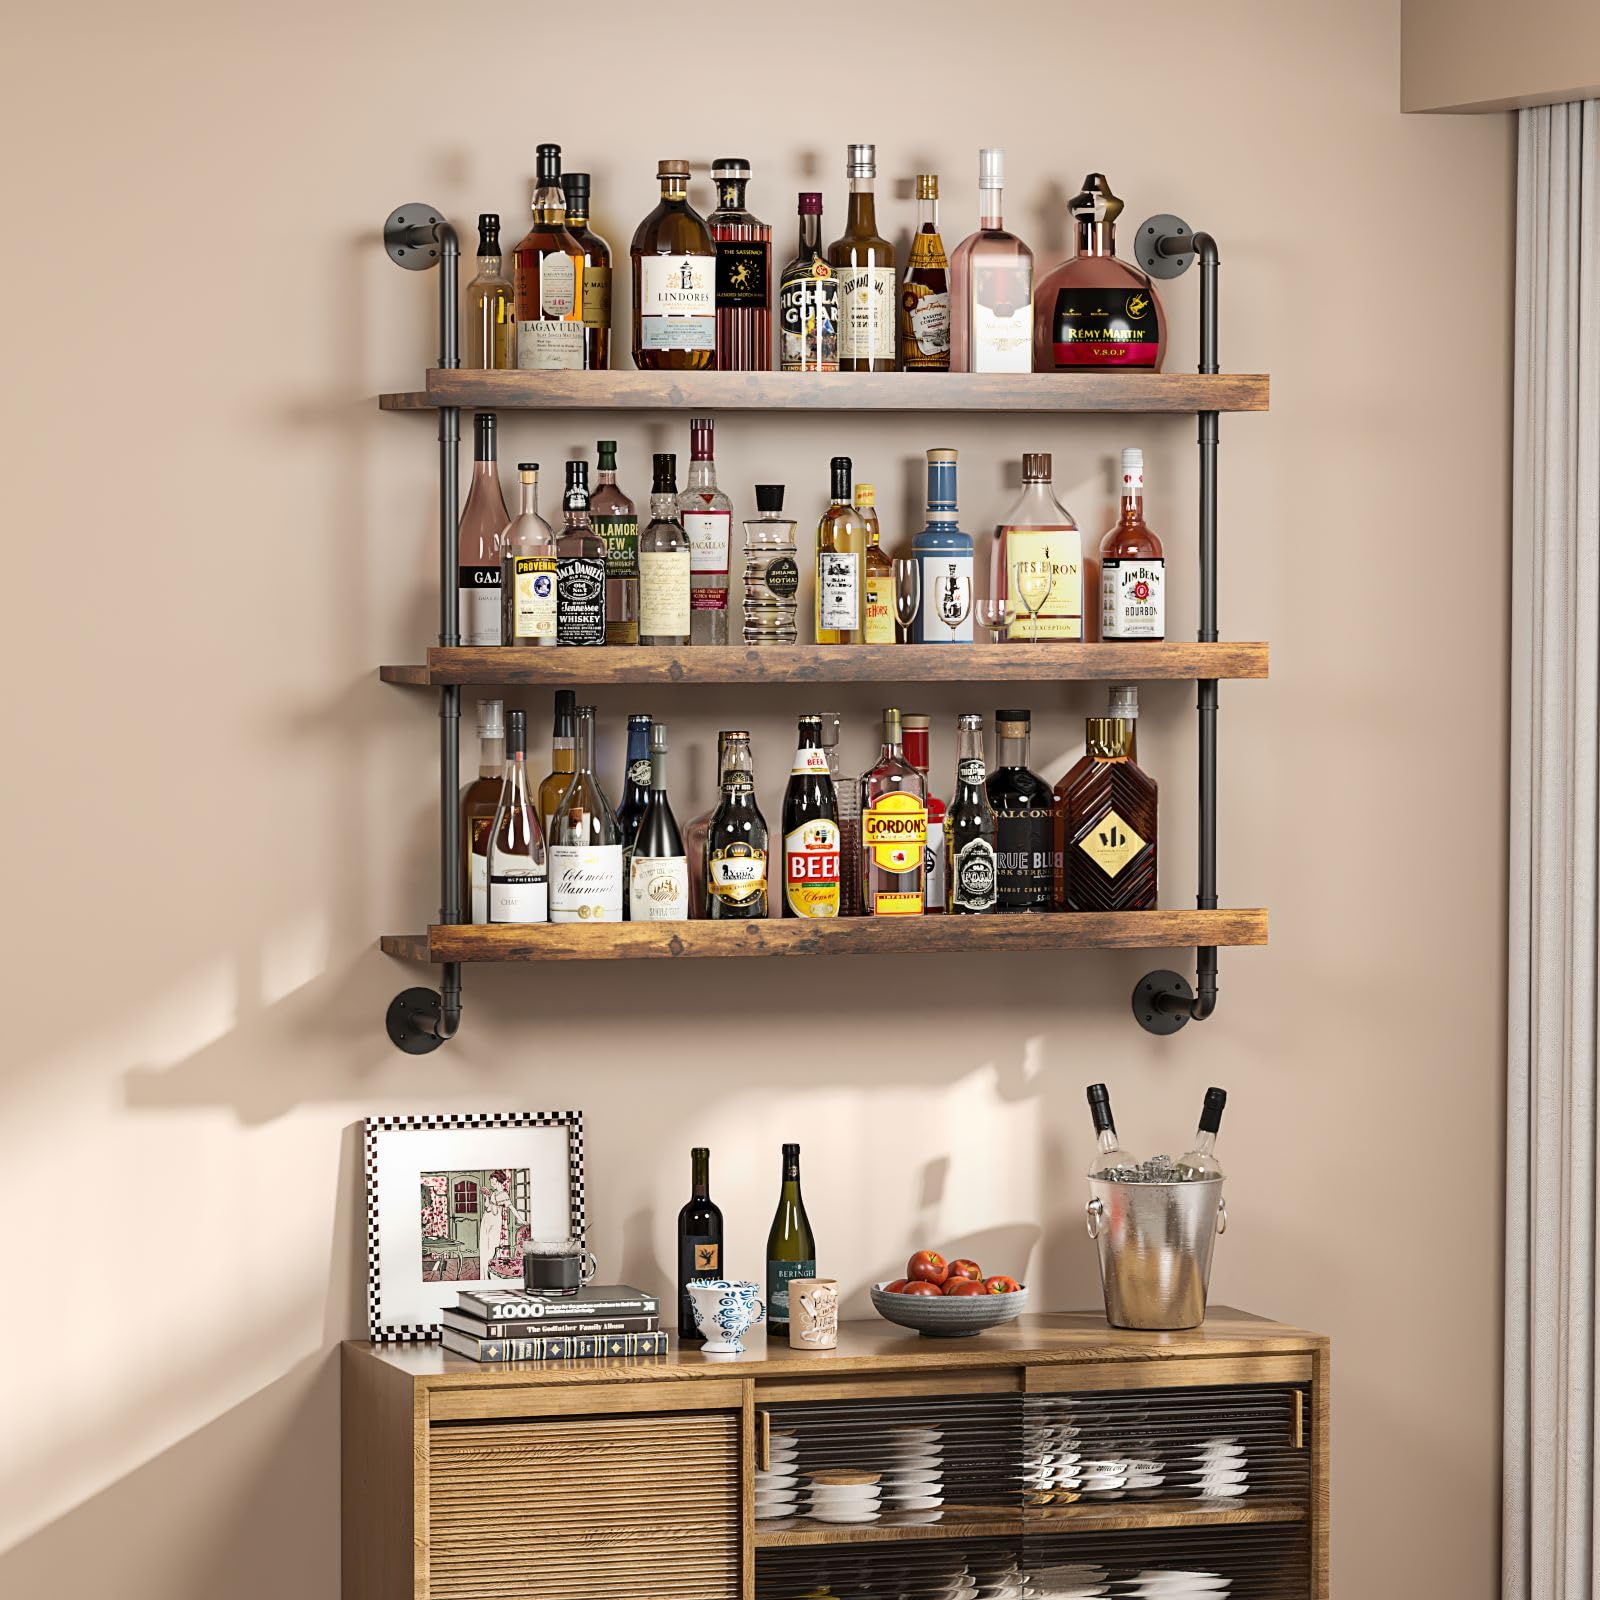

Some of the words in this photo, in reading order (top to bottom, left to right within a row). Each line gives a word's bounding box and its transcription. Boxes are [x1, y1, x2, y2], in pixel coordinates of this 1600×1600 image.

[658, 292, 709, 302] LINDORES
[1068, 328, 1100, 339] RÉMY
[1102, 328, 1143, 339] MARTIN
[604, 537, 626, 550] EW
[607, 547, 636, 560] tock
[474, 571, 502, 584] GAJ
[556, 564, 575, 581] JACK
[574, 561, 603, 581] DANIEL'S
[1122, 571, 1138, 586] JIM
[1139, 567, 1160, 585] BEAM
[561, 601, 599, 612] Tennessee
[1125, 606, 1158, 616] BOURBON
[558, 615, 601, 623] WHISKEY
[807, 758, 824, 767] BEER
[866, 817, 927, 834] GORDON'S
[791, 856, 841, 878] BEER
[997, 852, 1029, 869] RUE
[996, 868, 1014, 876] ASK
[492, 1303, 545, 1319] 1000
[542, 1324, 577, 1332] Godfather
[579, 1323, 602, 1331] Family
[603, 1322, 625, 1330] Album
